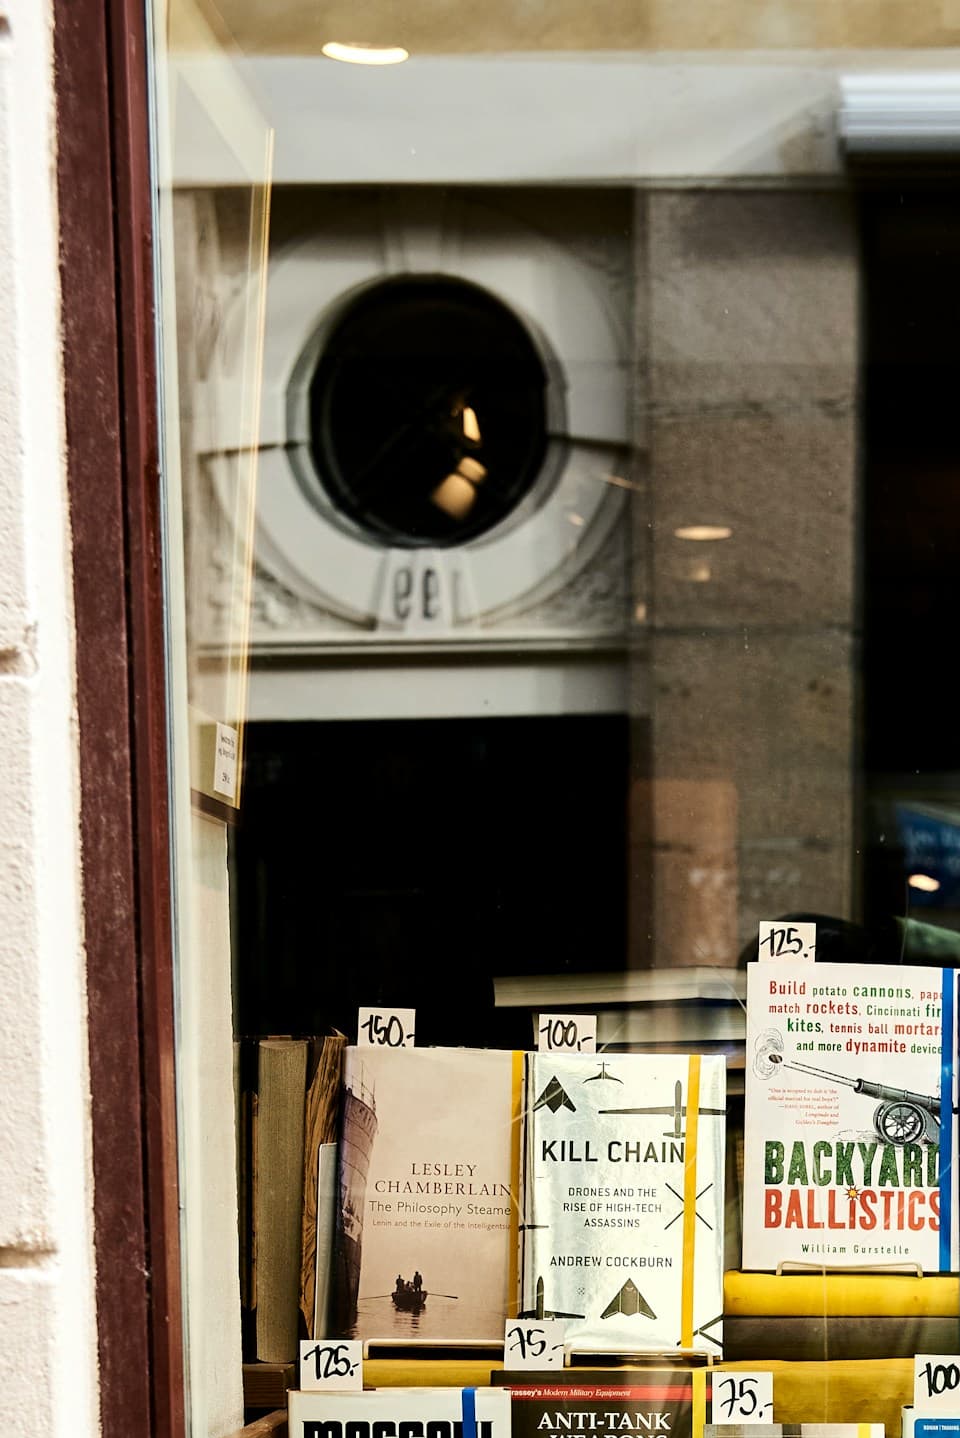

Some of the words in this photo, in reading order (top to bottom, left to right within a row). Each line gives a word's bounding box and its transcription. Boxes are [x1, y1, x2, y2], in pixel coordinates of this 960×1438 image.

[769, 980, 807, 995] Build
[812, 986, 847, 998] potato
[768, 1003, 801, 1014] match
[866, 1004, 921, 1018] Cincinnati
[830, 1023, 863, 1034] tennis
[868, 1023, 888, 1034] ball
[796, 1041, 814, 1052] and
[818, 1042, 842, 1052] more
[846, 1038, 907, 1055] dynamite
[542, 1140, 598, 1163] KILL
[607, 1141, 686, 1164] CHAIN
[411, 1162, 478, 1177] LESLEY
[375, 1180, 512, 1197] CHAMBERLAIN
[568, 1187, 611, 1198] DRONES
[613, 1187, 635, 1198] AND
[637, 1188, 657, 1198] THE
[368, 1201, 392, 1213] The
[397, 1202, 463, 1218] Philosophy
[563, 1202, 587, 1213] RISE
[589, 1202, 604, 1213] OF
[606, 1203, 662, 1213] HIGH-TECH
[764, 1188, 941, 1232] BALLISTICS
[584, 1218, 640, 1228] ASSASSINS
[801, 1243, 847, 1255] William
[853, 1244, 910, 1255] Gurstelle
[549, 1256, 602, 1268] ANDREW
[605, 1256, 673, 1268] COCKBURN
[537, 1411, 672, 1430] ANTI-TANK
